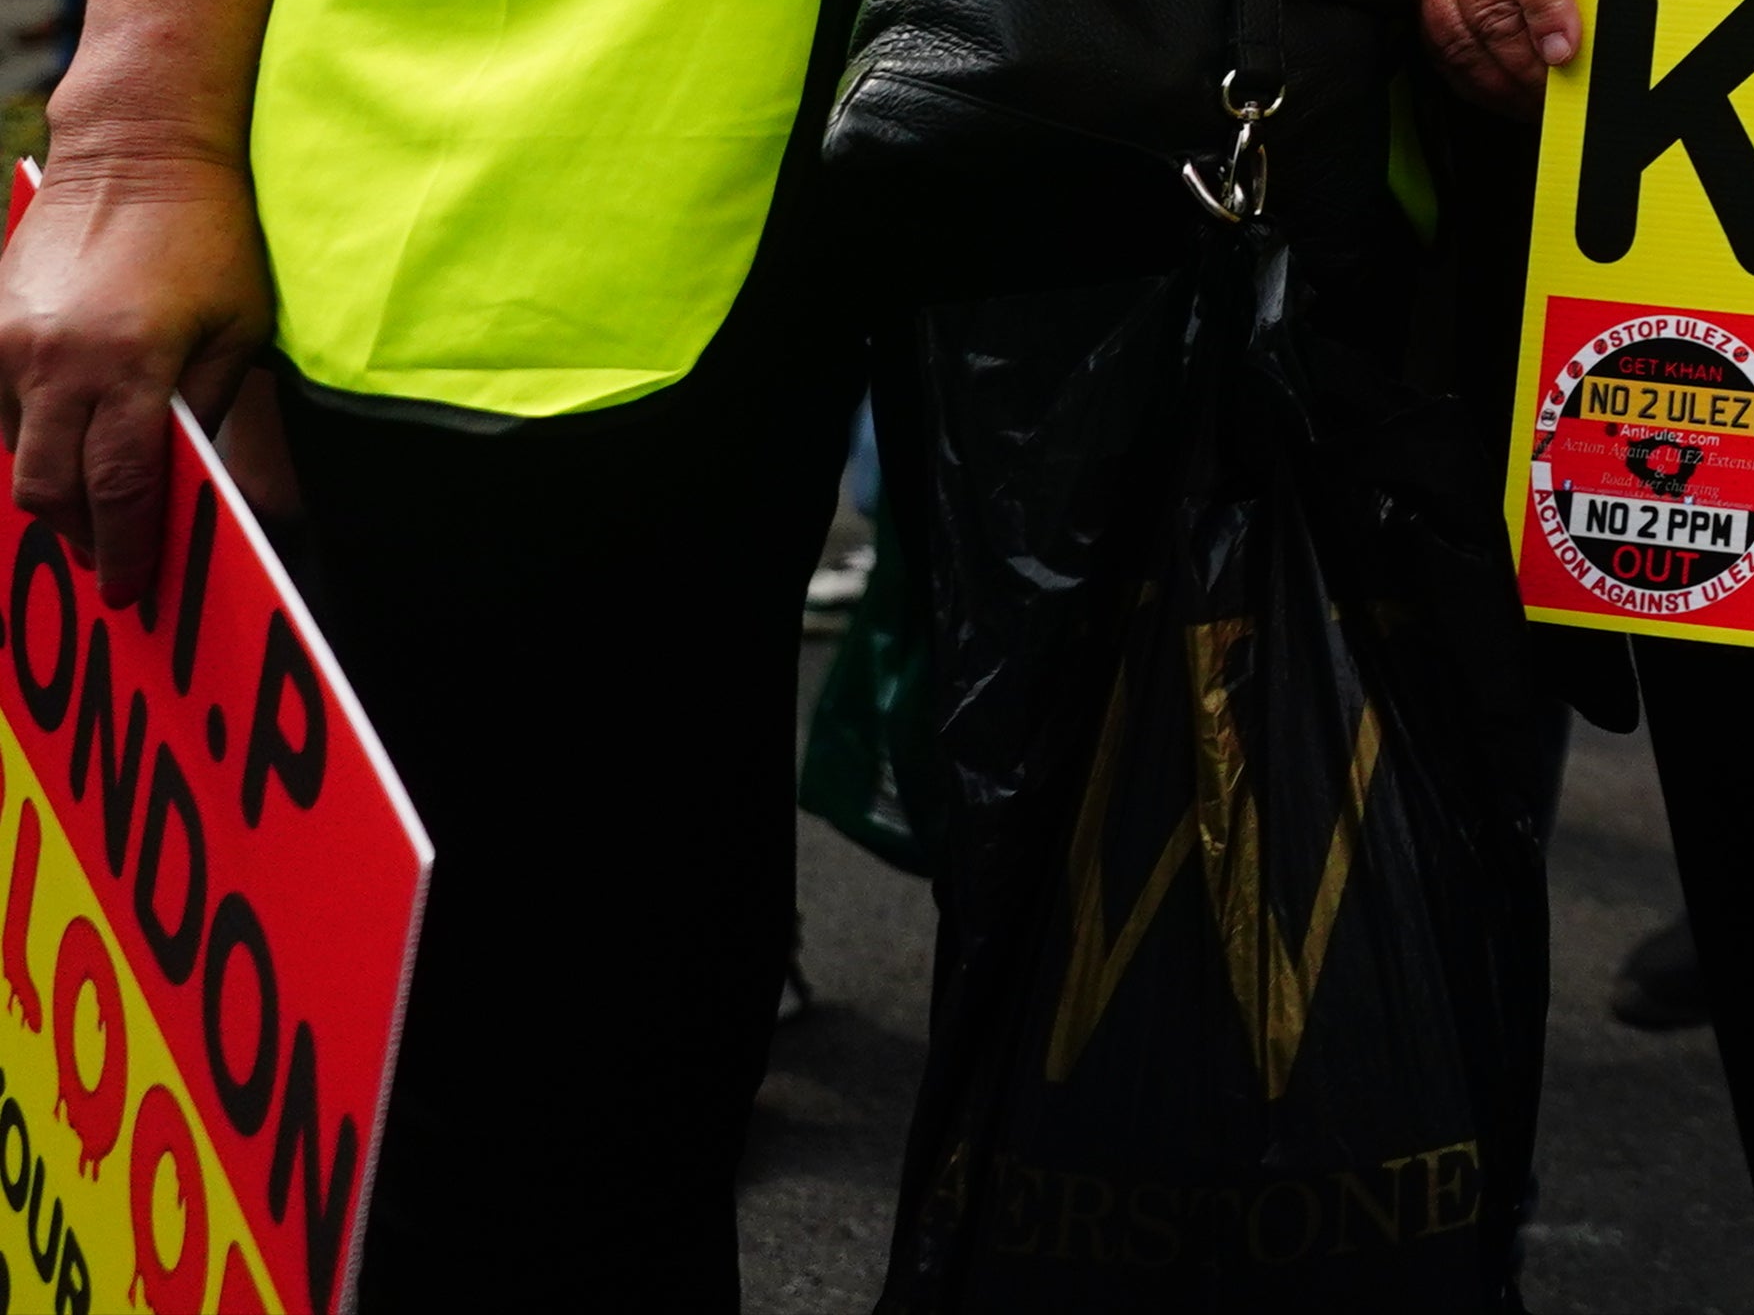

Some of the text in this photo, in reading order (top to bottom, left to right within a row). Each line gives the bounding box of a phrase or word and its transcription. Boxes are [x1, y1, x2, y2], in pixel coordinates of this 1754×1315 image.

[1609, 319, 1729, 354] STOP ULEZ
[1619, 356, 1724, 383] GET KHAN
[1589, 382, 1752, 429] NO 2 ULEZ
[1561, 437, 1605, 455] Action
[1610, 442, 1660, 464] Against
[1664, 447, 1704, 465] ULEZ
[1620, 424, 1720, 447] Anti-ulez.com
[1601, 473, 1633, 488] Road
[1664, 479, 1720, 499] charging
[1586, 499, 1733, 547] NO 2 PPM
[1534, 488, 1592, 580] ACTION
[1591, 577, 1693, 613] AGAINST
[1613, 544, 1700, 585] OUT
[137, 478, 328, 829] .I.P
[0, 516, 359, 1315] ONDON
[0, 1095, 91, 1315] OUR
